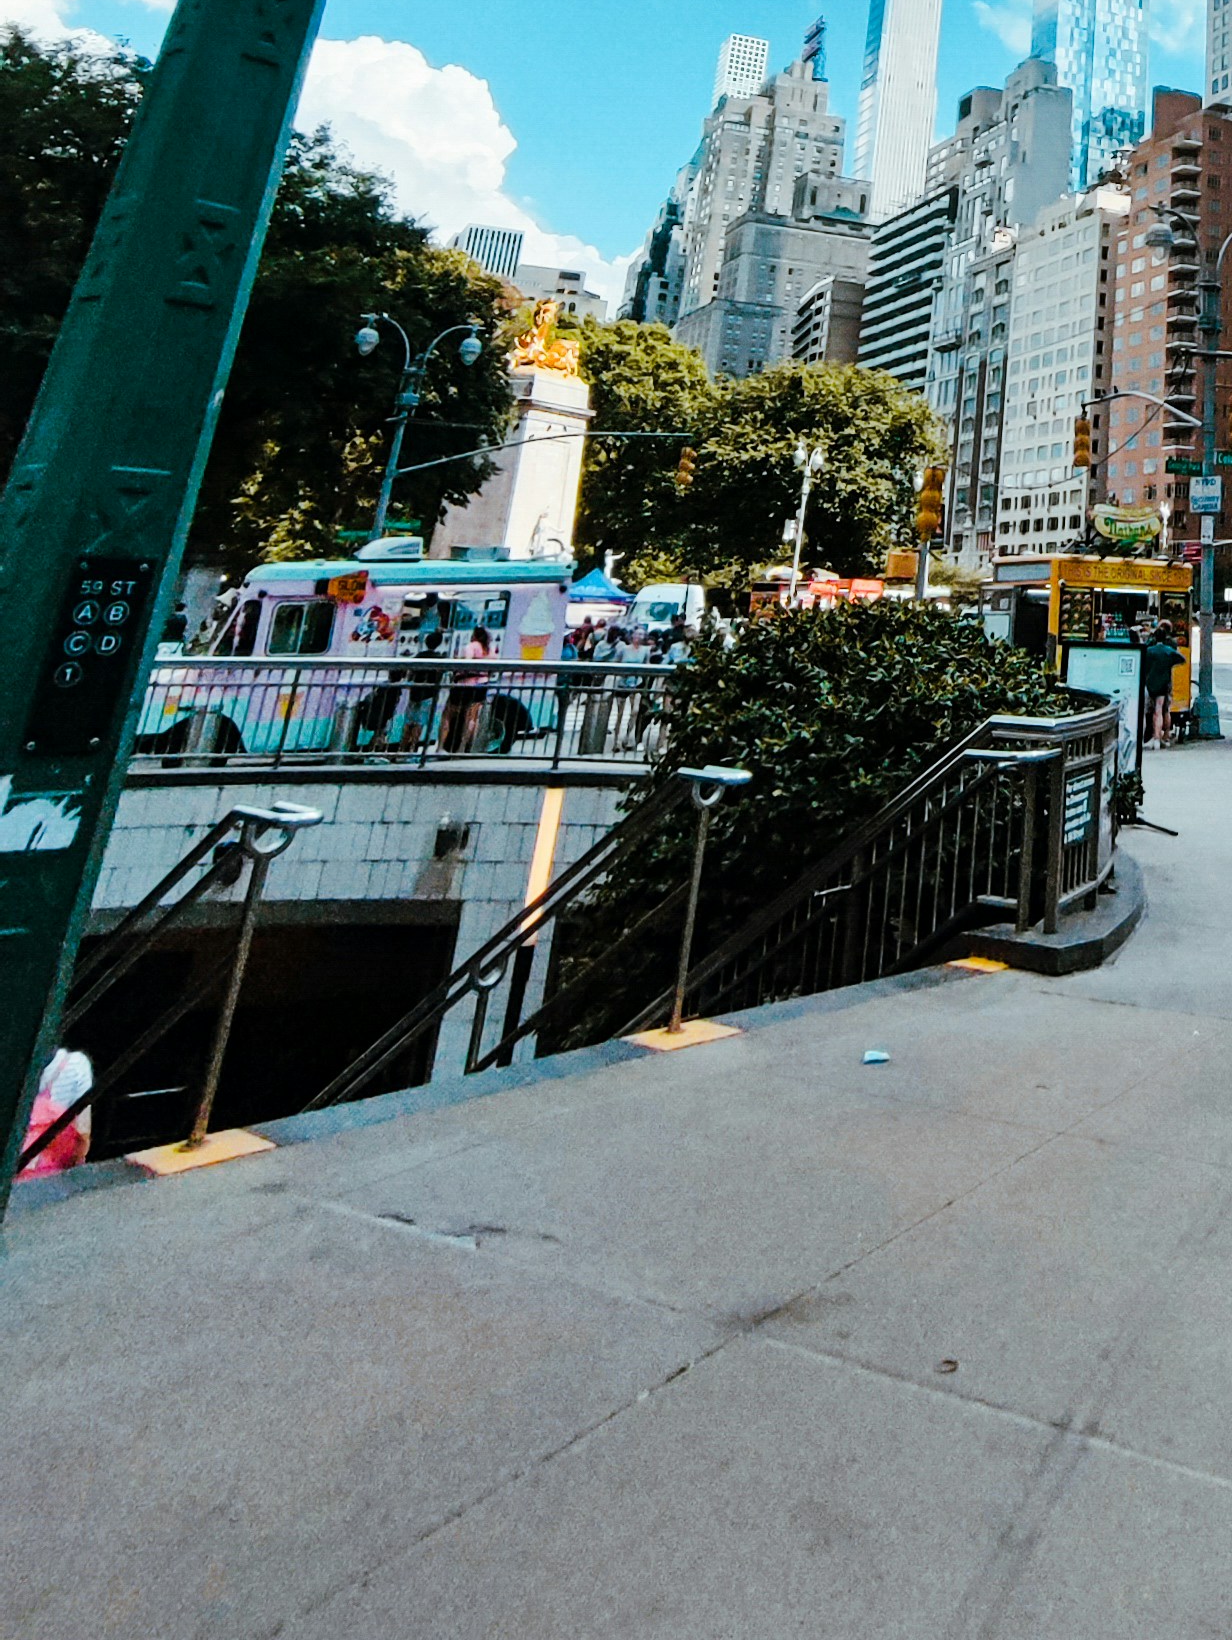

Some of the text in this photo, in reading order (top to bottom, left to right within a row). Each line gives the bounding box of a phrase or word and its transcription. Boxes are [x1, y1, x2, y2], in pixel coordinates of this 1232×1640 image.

[80, 580, 137, 595] 59 ST
[77, 604, 124, 621] A B
[69, 635, 116, 652] C D
